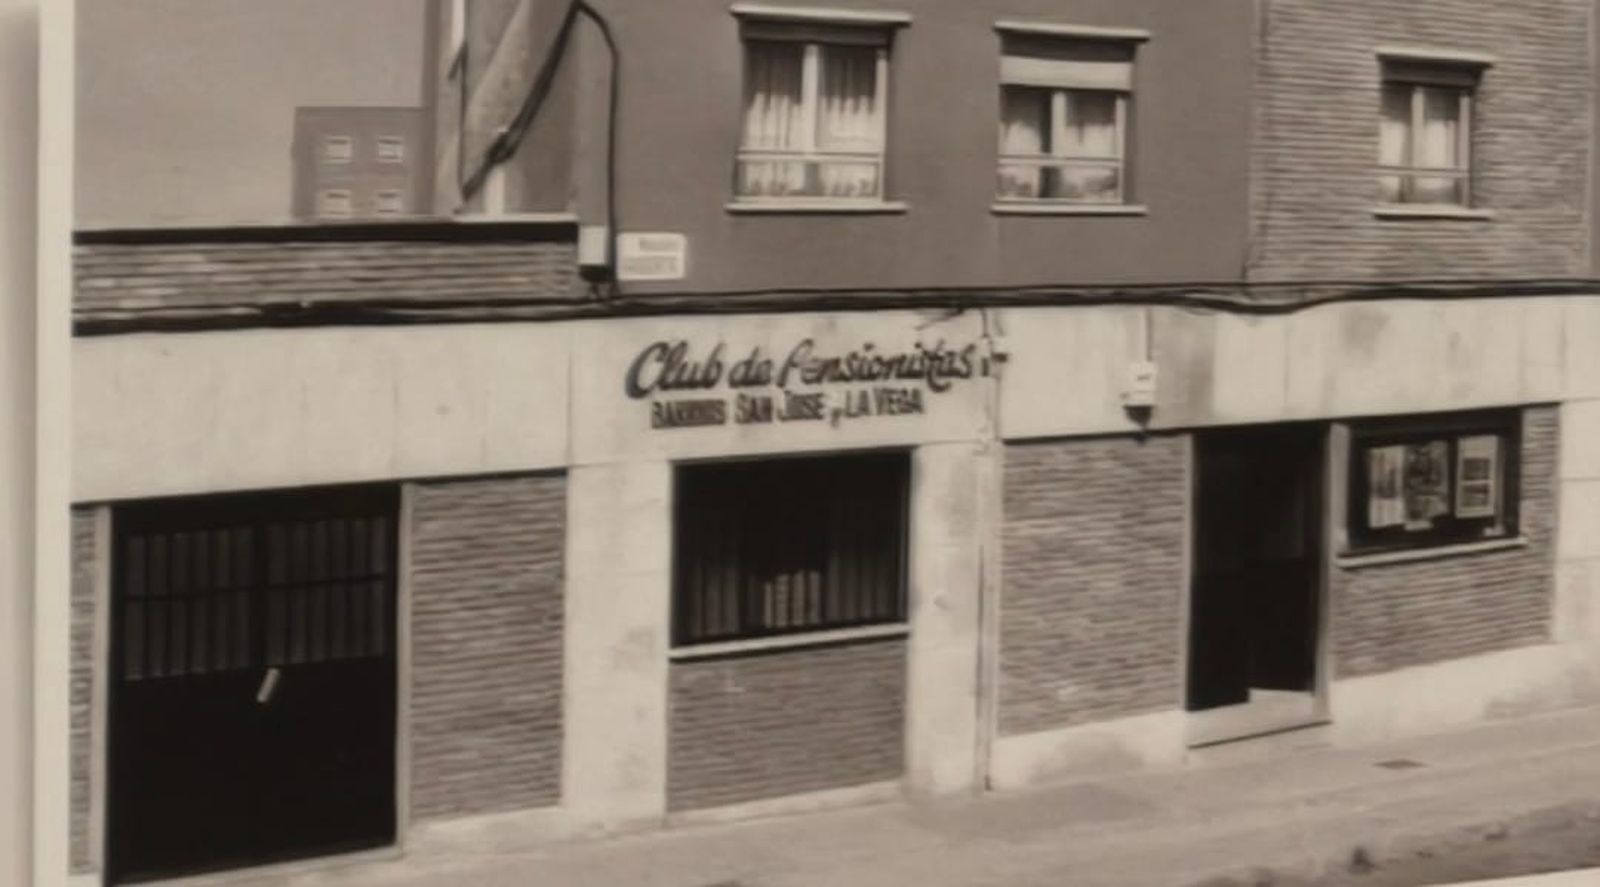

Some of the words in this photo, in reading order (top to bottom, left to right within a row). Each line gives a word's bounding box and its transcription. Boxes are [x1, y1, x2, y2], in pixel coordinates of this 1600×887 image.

[626, 341, 724, 398] Club
[729, 346, 773, 388] de
[777, 338, 974, 391] Pensionistas
[735, 393, 772, 423] SAN
[845, 390, 871, 417] LA
